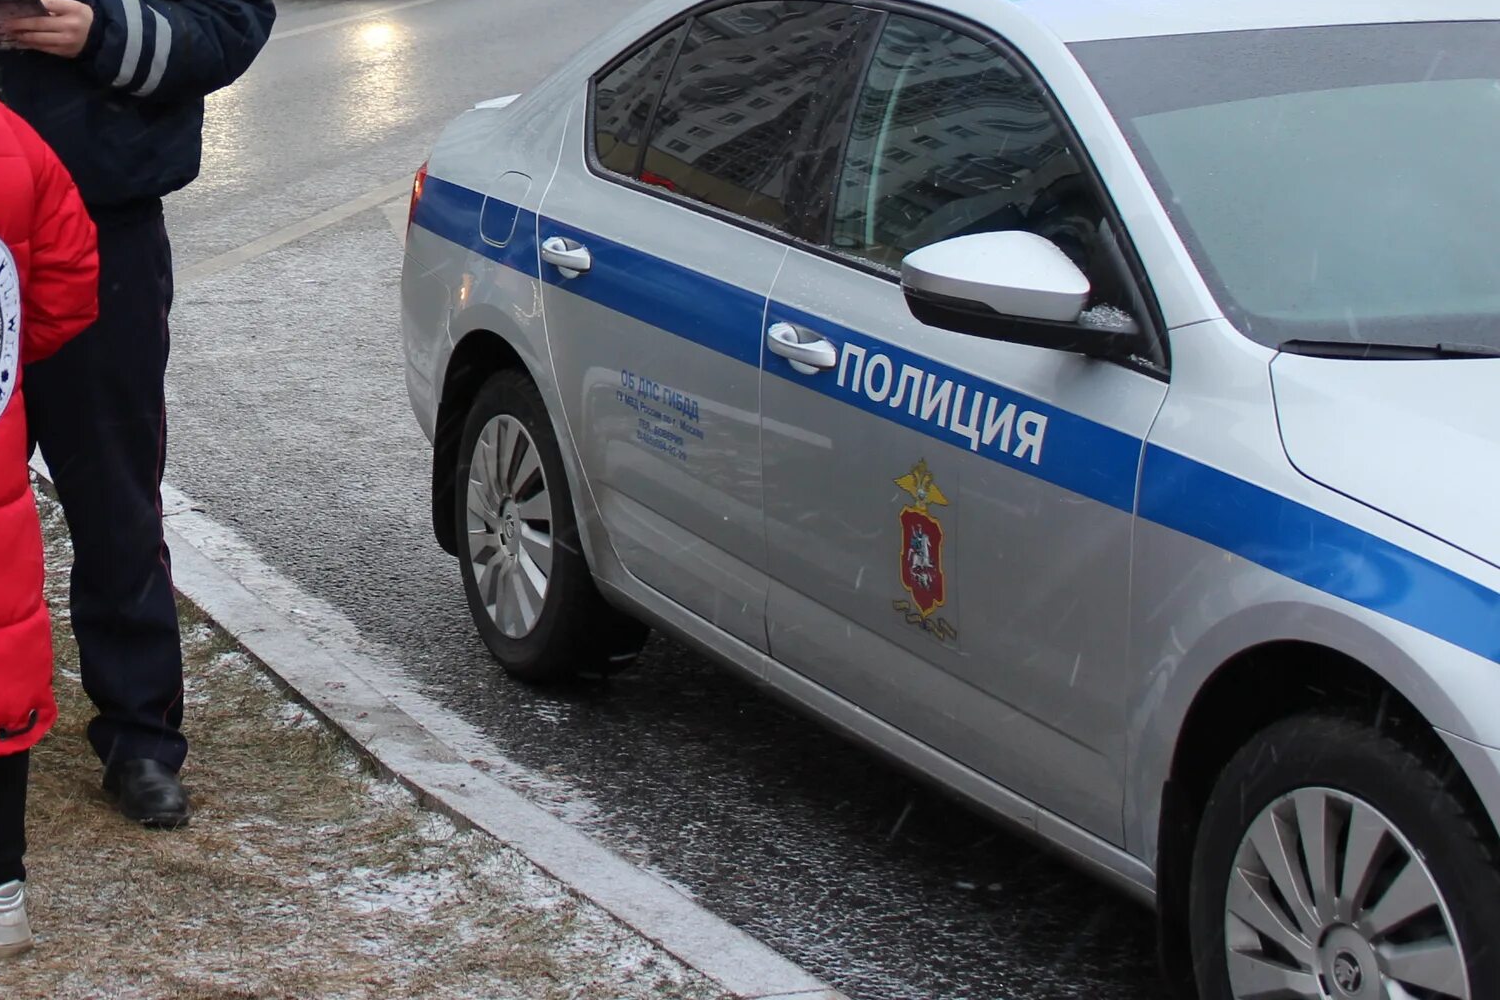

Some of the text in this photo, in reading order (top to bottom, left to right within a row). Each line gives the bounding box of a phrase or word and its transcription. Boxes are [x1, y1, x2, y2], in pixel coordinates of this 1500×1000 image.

[621, 368, 699, 423] ОБ ДПС ГИБДД
[834, 342, 1049, 466] ПОЛИЦИЯ
